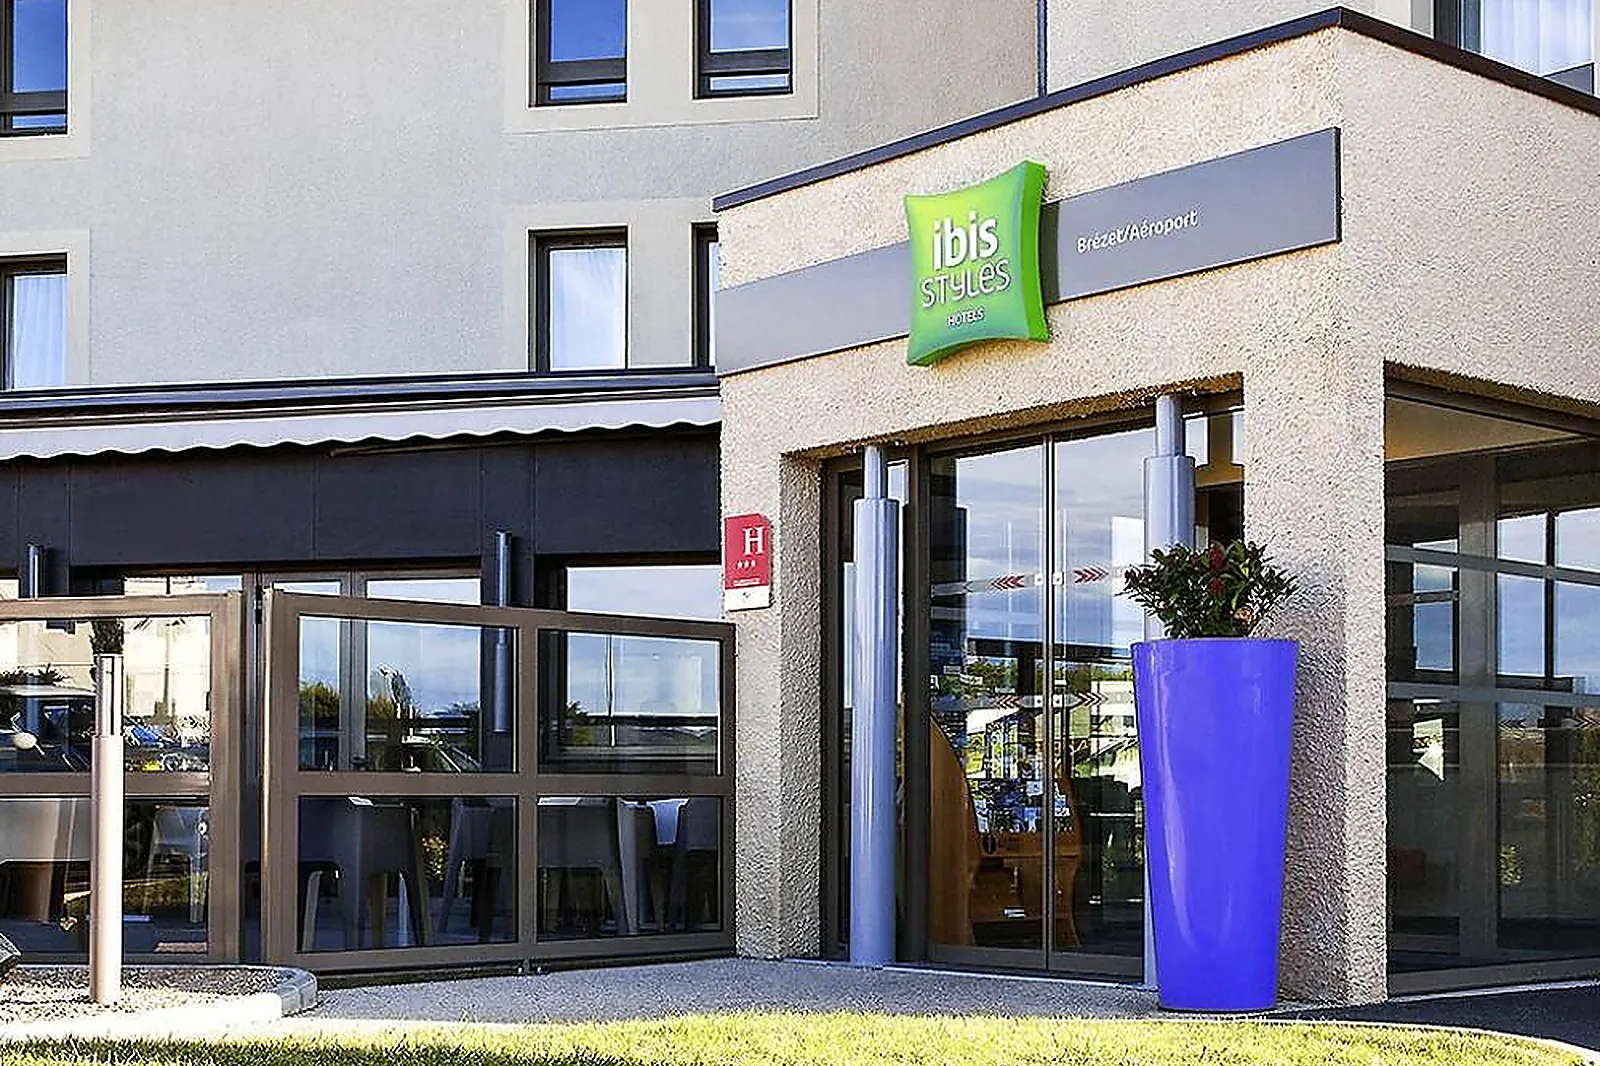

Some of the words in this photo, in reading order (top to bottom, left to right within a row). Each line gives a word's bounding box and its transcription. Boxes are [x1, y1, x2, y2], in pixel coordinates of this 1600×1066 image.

[932, 211, 998, 271] ibis
[1077, 209, 1198, 253] Brézet/Aéroport
[947, 307, 985, 327] HOTELS
[743, 526, 765, 557] H
